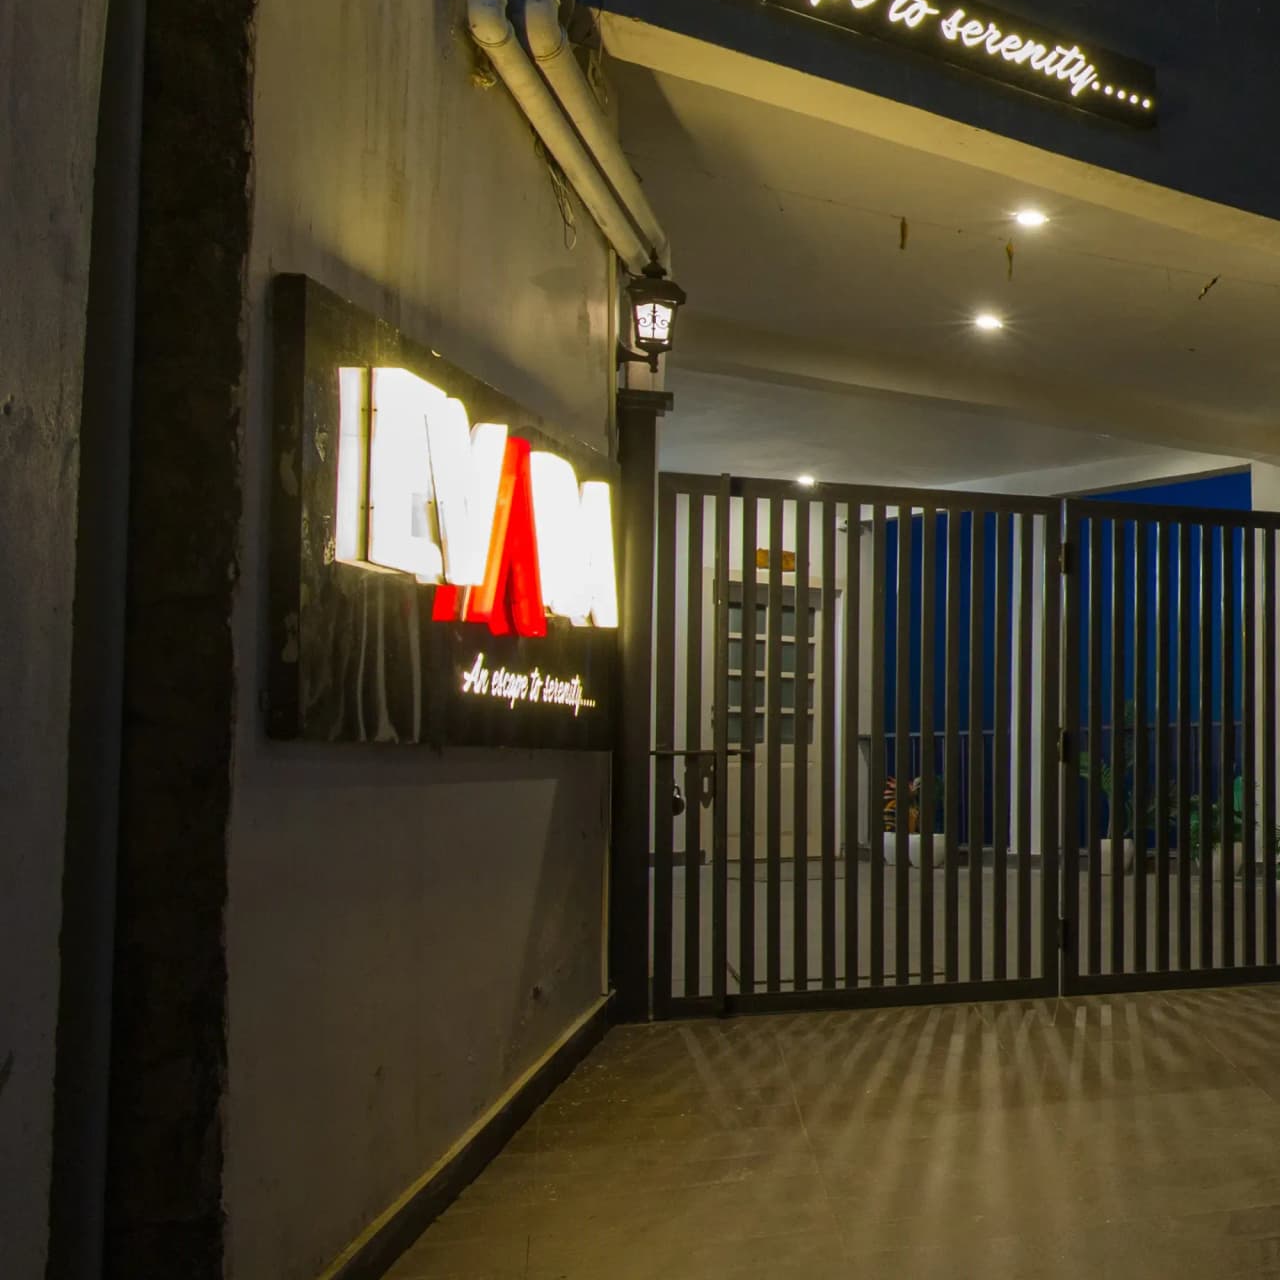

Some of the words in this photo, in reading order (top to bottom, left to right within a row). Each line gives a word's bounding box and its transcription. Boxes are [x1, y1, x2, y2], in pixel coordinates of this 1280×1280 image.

[461, 651, 489, 695] An
[491, 666, 529, 710] escape
[529, 666, 543, 702] to
